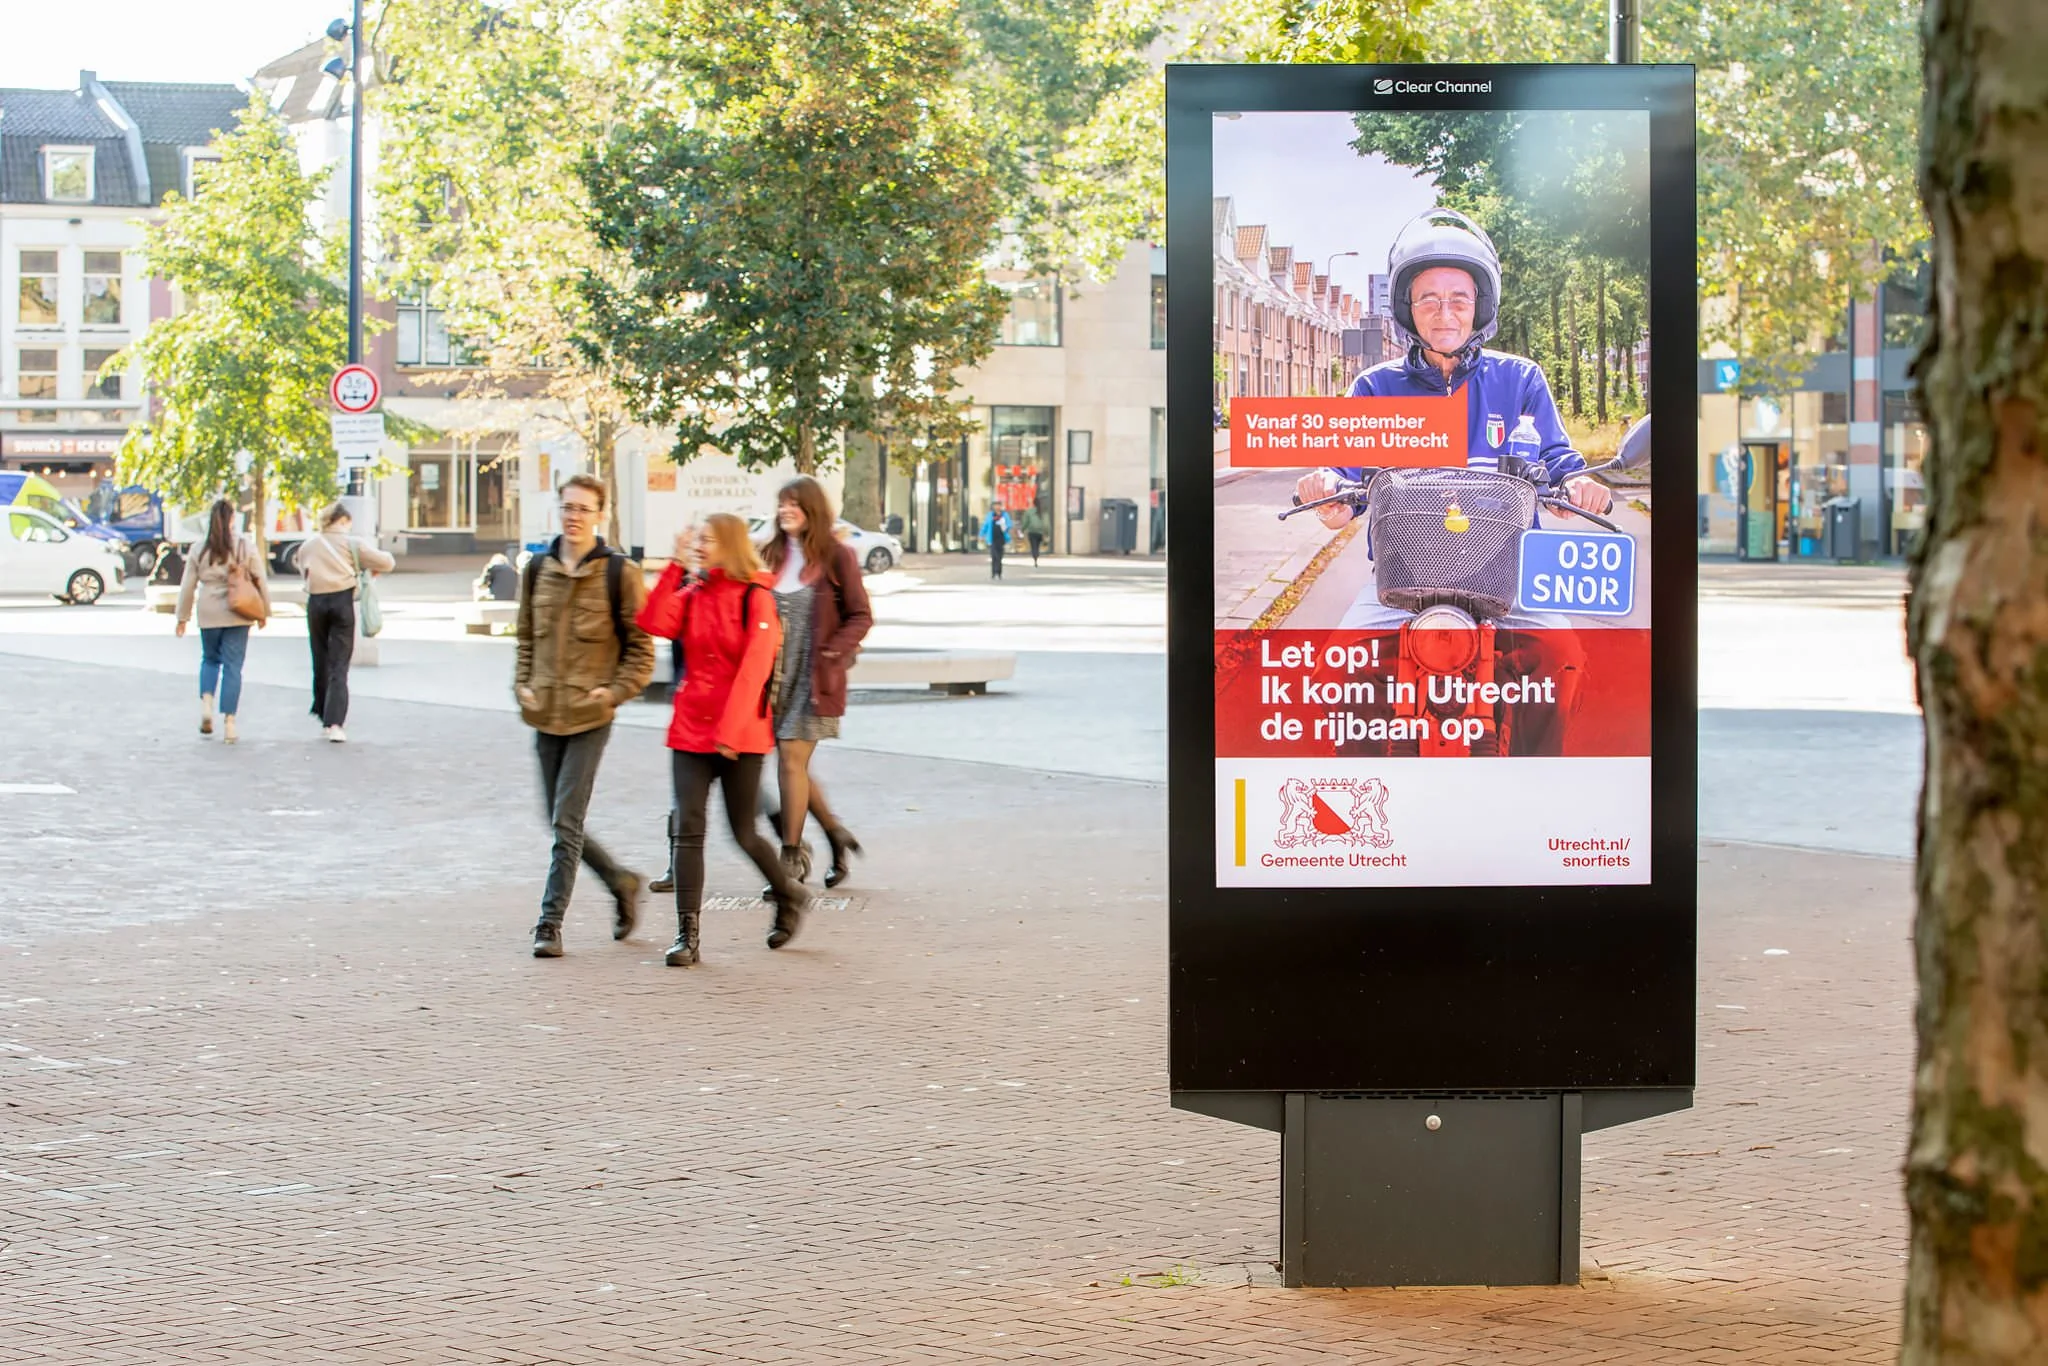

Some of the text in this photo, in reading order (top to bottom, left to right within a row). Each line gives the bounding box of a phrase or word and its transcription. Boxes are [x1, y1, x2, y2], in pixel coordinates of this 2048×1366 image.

[1395, 80, 1492, 93] Clear Channel
[1245, 414, 1426, 432] Vanaf 30 september
[1246, 433, 1449, 448] In het hart van Utrecht
[1558, 540, 1622, 571] 030
[1532, 573, 1619, 606] SNOR
[1261, 639, 1380, 673] Let op!
[1261, 675, 1556, 704] Ik kom in Utrecht
[1260, 712, 1484, 747] de rijbaan op
[1548, 838, 1631, 851] Utrecht.nl/
[1261, 853, 1407, 867] Gemeente Utrecht
[1562, 854, 1630, 867] snorfiets
